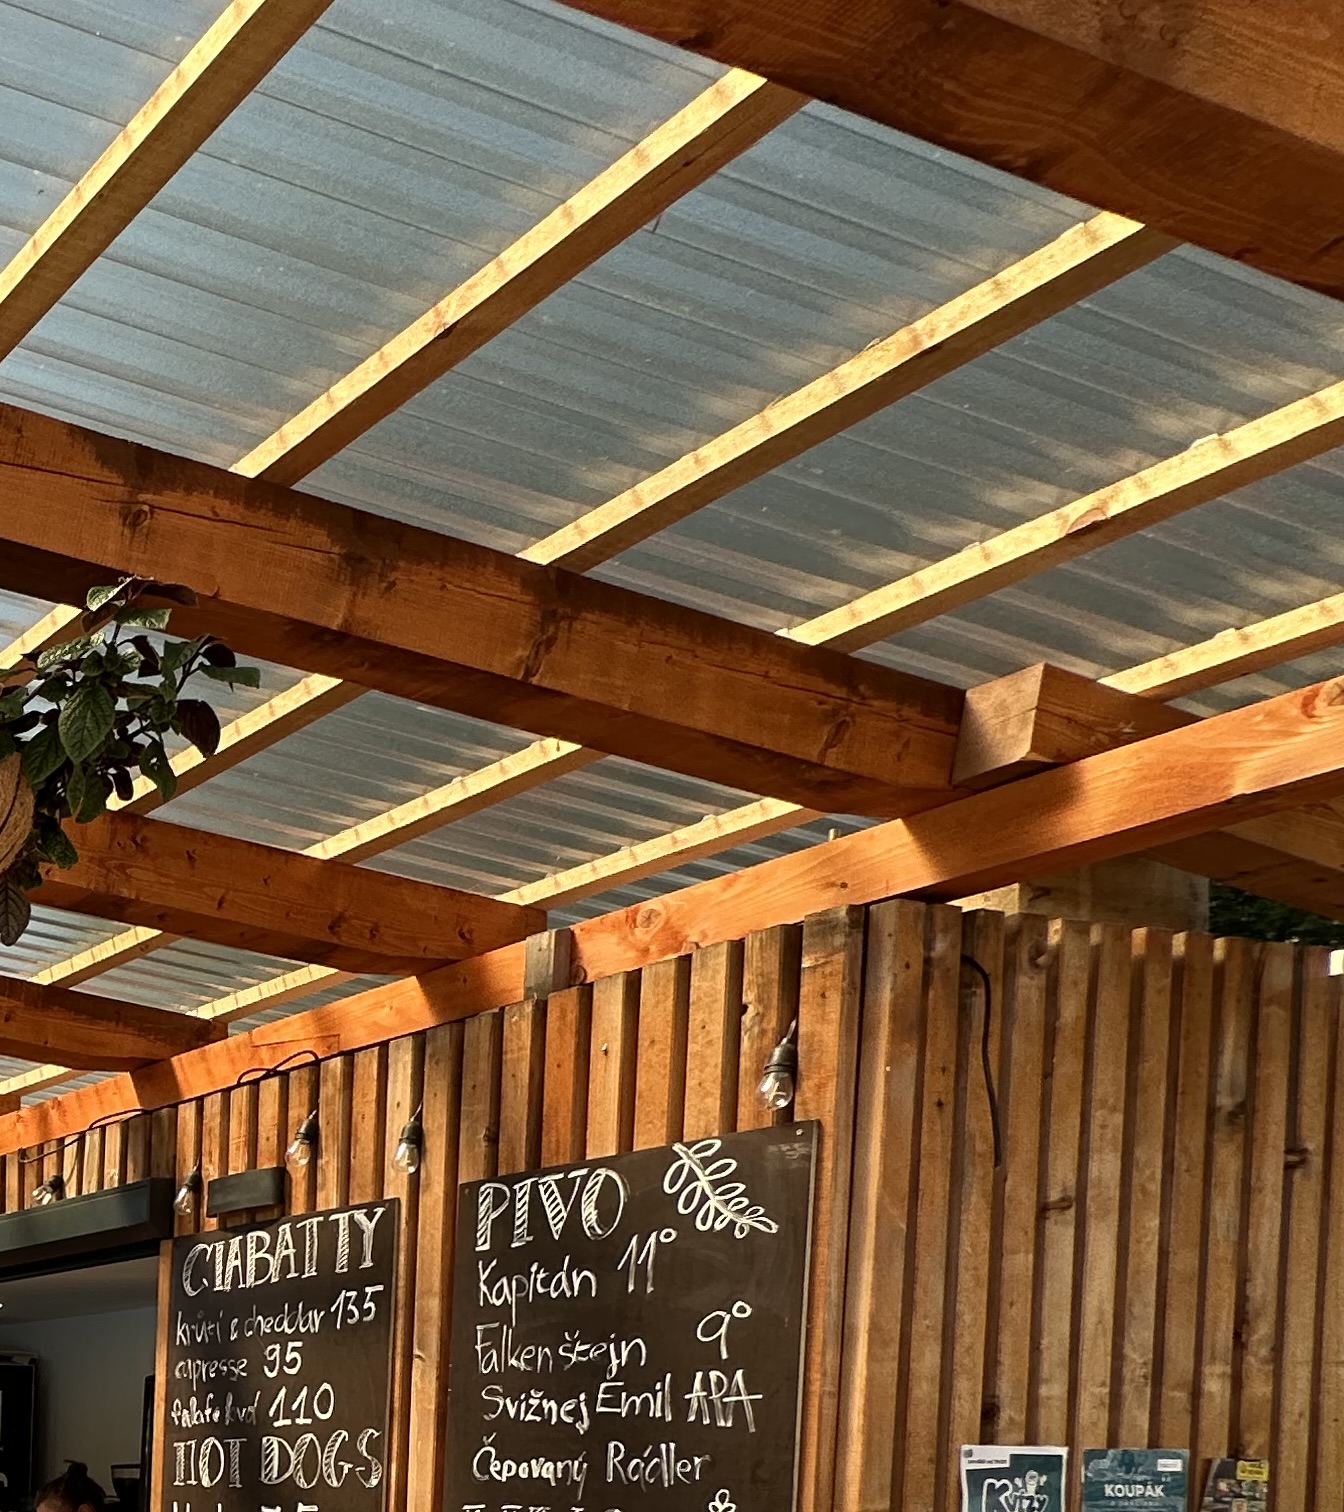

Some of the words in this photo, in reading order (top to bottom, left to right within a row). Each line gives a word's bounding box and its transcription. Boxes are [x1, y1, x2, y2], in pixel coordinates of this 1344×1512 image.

[475, 1167, 630, 1251] PIVO
[183, 1208, 386, 1297] CIABATTY
[243, 1301, 325, 1338] cheddar
[330, 1285, 384, 1329] 135
[263, 1341, 304, 1379] 95
[269, 1382, 335, 1428] 110
[481, 1384, 590, 1434] Svižnej
[595, 1373, 673, 1423] Emil
[684, 1368, 762, 1433] APA
[173, 1436, 248, 1489] HOT
[259, 1428, 383, 1490] DOGS
[472, 1433, 589, 1499] Čepovaný
[1103, 1481, 1167, 1498] KOUPÁK
